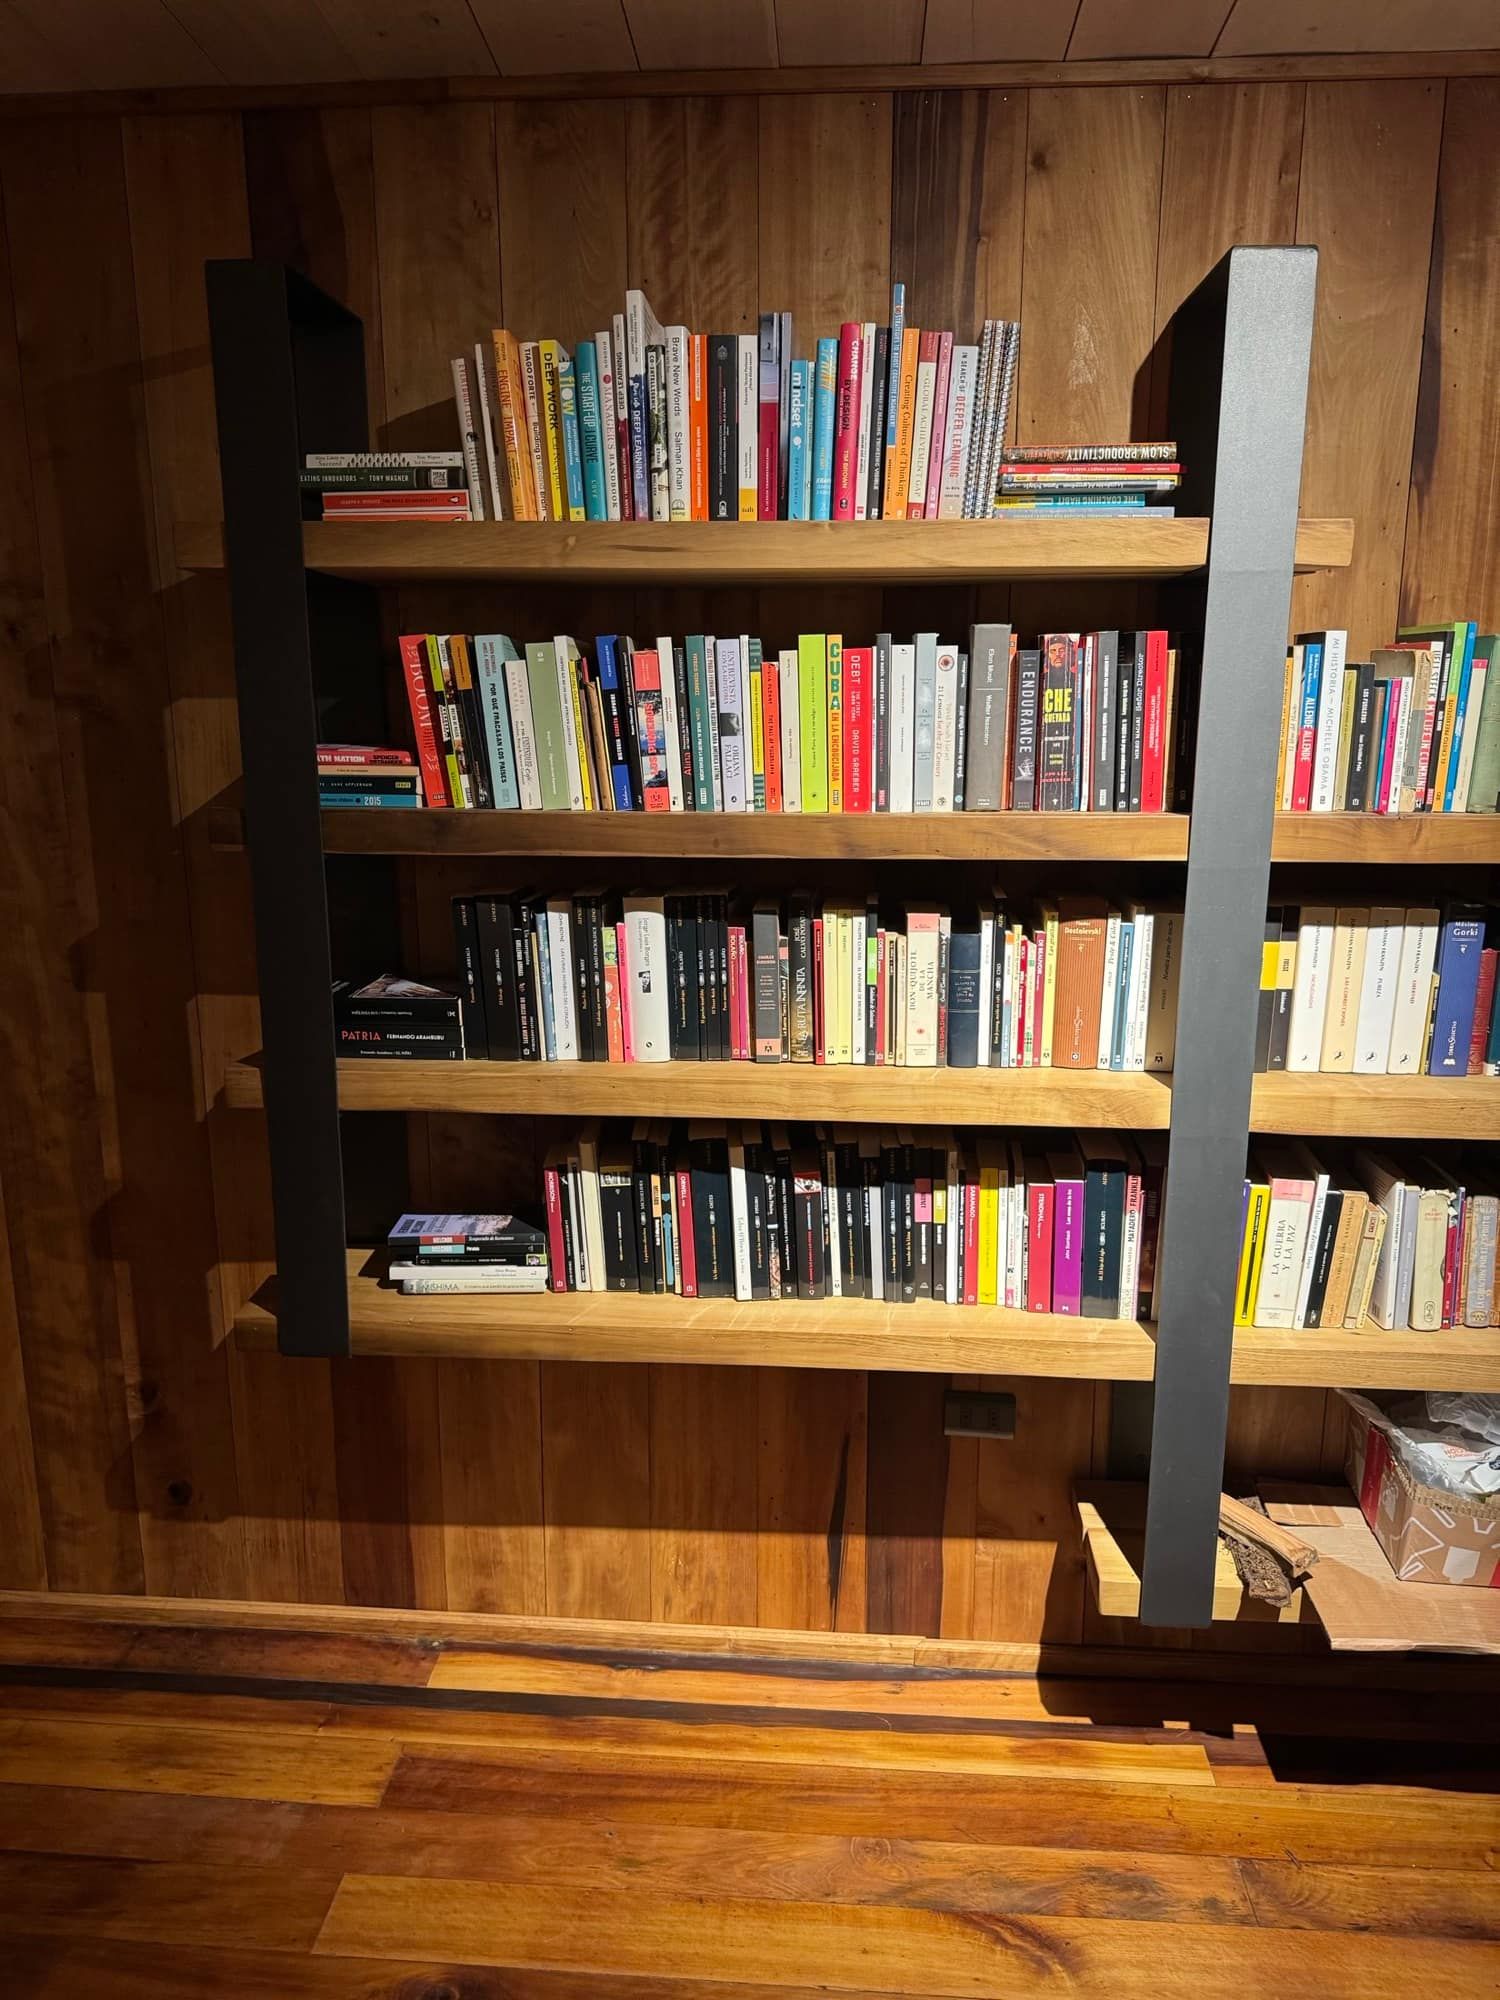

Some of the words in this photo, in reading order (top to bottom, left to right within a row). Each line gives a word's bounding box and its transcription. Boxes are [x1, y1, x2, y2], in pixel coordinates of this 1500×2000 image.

[524, 348, 532, 373] TIAGO
[672, 337, 681, 362] Brave
[850, 340, 858, 380] CHANGE
[543, 353, 556, 388] DEEP
[581, 372, 590, 383] THE
[672, 365, 682, 385] New
[500, 370, 511, 408] ENGINE
[526, 375, 536, 400] FORTE
[561, 376, 575, 416] flow
[791, 372, 806, 428] mindset
[843, 379, 851, 394] BY
[901, 374, 913, 410] Creating
[546, 391, 559, 430] WORK
[582, 386, 594, 427] START-UP
[673, 388, 682, 416] Words
[842, 396, 851, 430] DESIGN
[954, 396, 966, 430] DEEPER
[503, 416, 516, 454] IMPACT
[633, 410, 642, 433] DEEP
[900, 412, 911, 446] Cultures
[532, 422, 541, 453] Building
[585, 435, 598, 463] CURVE
[674, 431, 683, 459] Salman
[635, 435, 644, 479] LEARNING
[842, 450, 850, 462] TIM
[900, 447, 909, 458] of
[949, 433, 962, 478] LEARNING
[1066, 447, 1137, 461] PRODUCTIVITY
[1141, 446, 1169, 458] SLOW
[369, 474, 384, 482] TONY
[609, 454, 618, 508] HANDBOOK
[675, 461, 684, 490] Khan
[896, 460, 907, 497] Thinking
[1083, 496, 1117, 504] COACHING
[1332, 638, 1340, 649] MI
[851, 655, 861, 684] DEBT
[1329, 652, 1339, 694] HISTORIA
[489, 683, 497, 695] POR
[1045, 688, 1072, 712] CHE
[1019, 672, 1035, 753] ENDURANCE
[1304, 697, 1315, 729] ALLENDE
[1425, 702, 1436, 716] MY
[492, 712, 502, 746] FRACASAN
[1323, 708, 1334, 752] MICHELLE
[1423, 719, 1433, 737] LIFE
[852, 730, 860, 755] DAVID
[1301, 730, 1313, 762] ALLENDE
[1421, 740, 1431, 748] IN
[852, 757, 860, 792] GRAEBER
[1321, 756, 1330, 789] OBAMA
[364, 797, 381, 805] 2015
[1453, 928, 1478, 936] Gorki
[341, 1030, 381, 1040] PATRIA
[1128, 1209, 1136, 1242] MATADERO
[1274, 1219, 1286, 1258] GUERRA
[1287, 1224, 1296, 1242] PAZ
[1284, 1247, 1293, 1259] LA
[1271, 1263, 1280, 1275] LA
